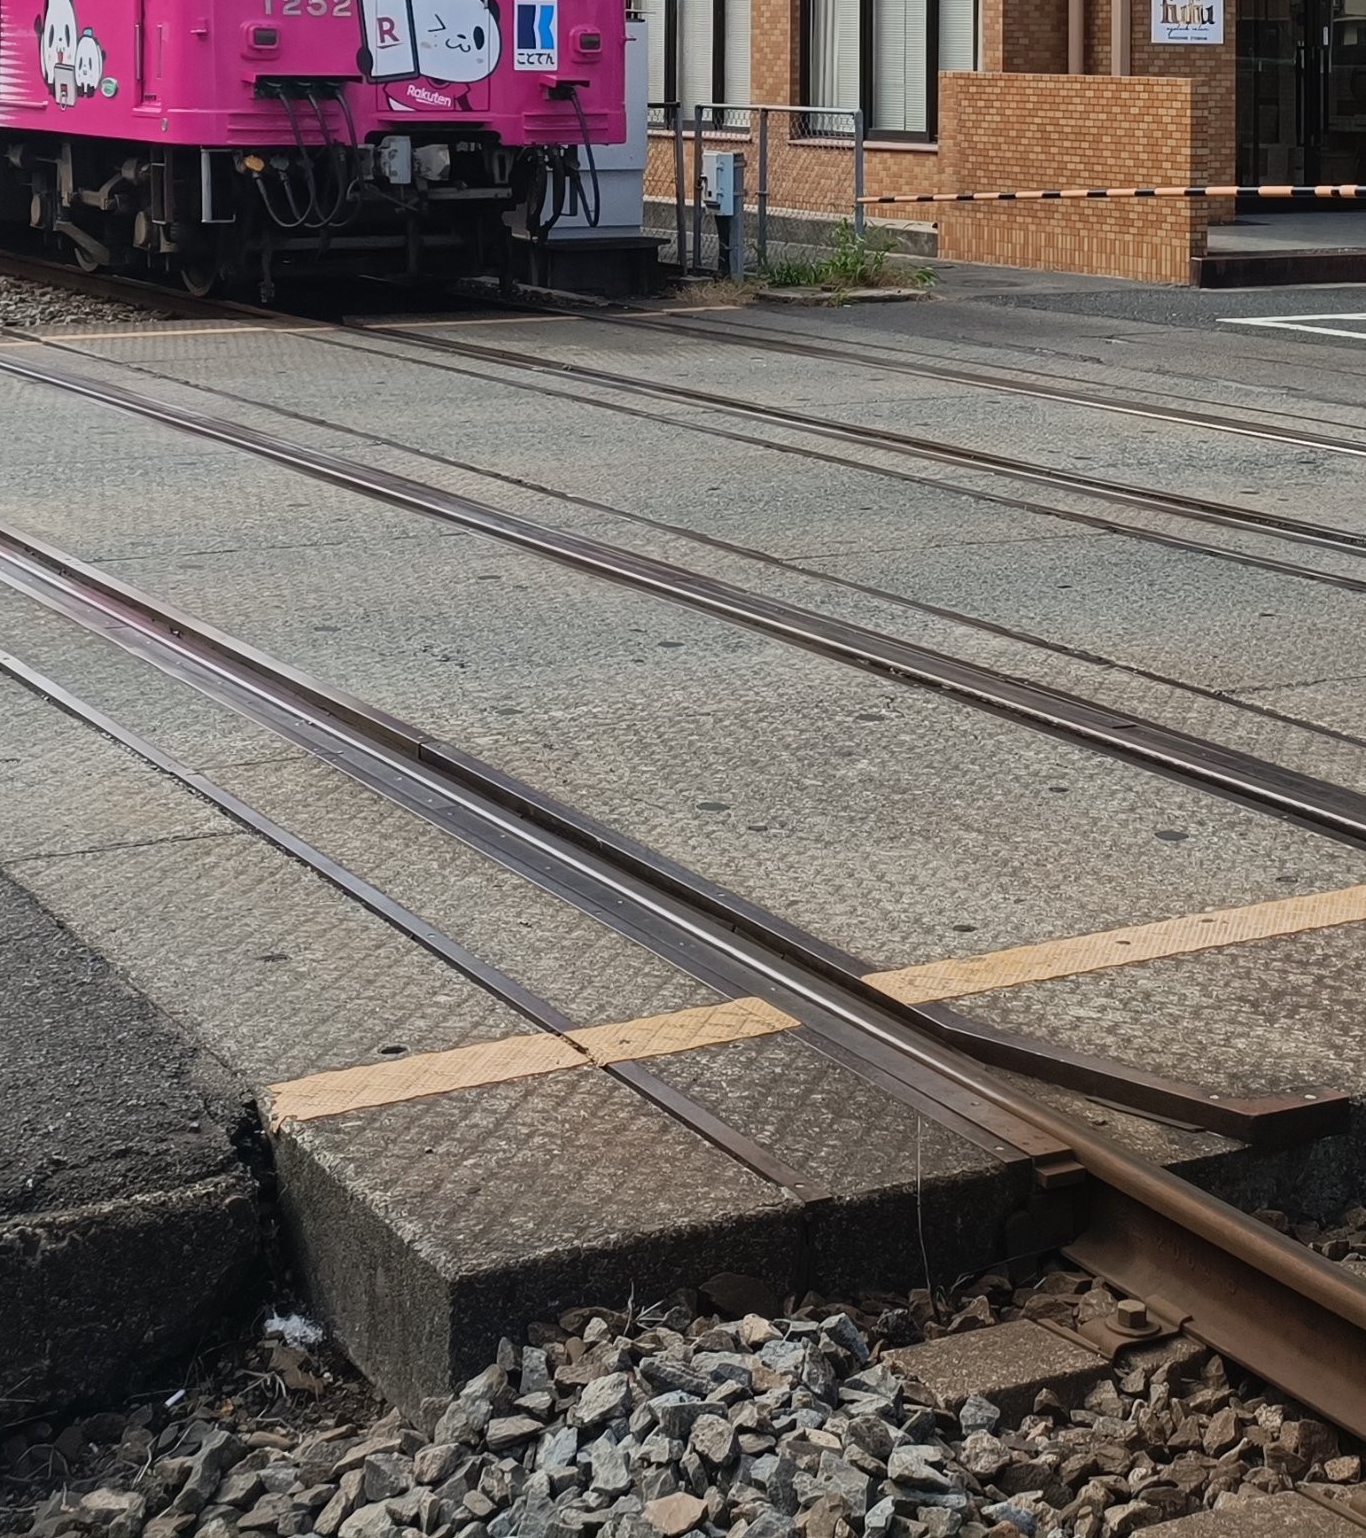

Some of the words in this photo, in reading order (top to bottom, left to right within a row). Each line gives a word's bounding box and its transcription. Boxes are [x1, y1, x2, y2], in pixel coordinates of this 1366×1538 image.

[376, 16, 400, 44] R
[517, 52, 556, 66] ことでん
[406, 83, 452, 108] Rakuten
